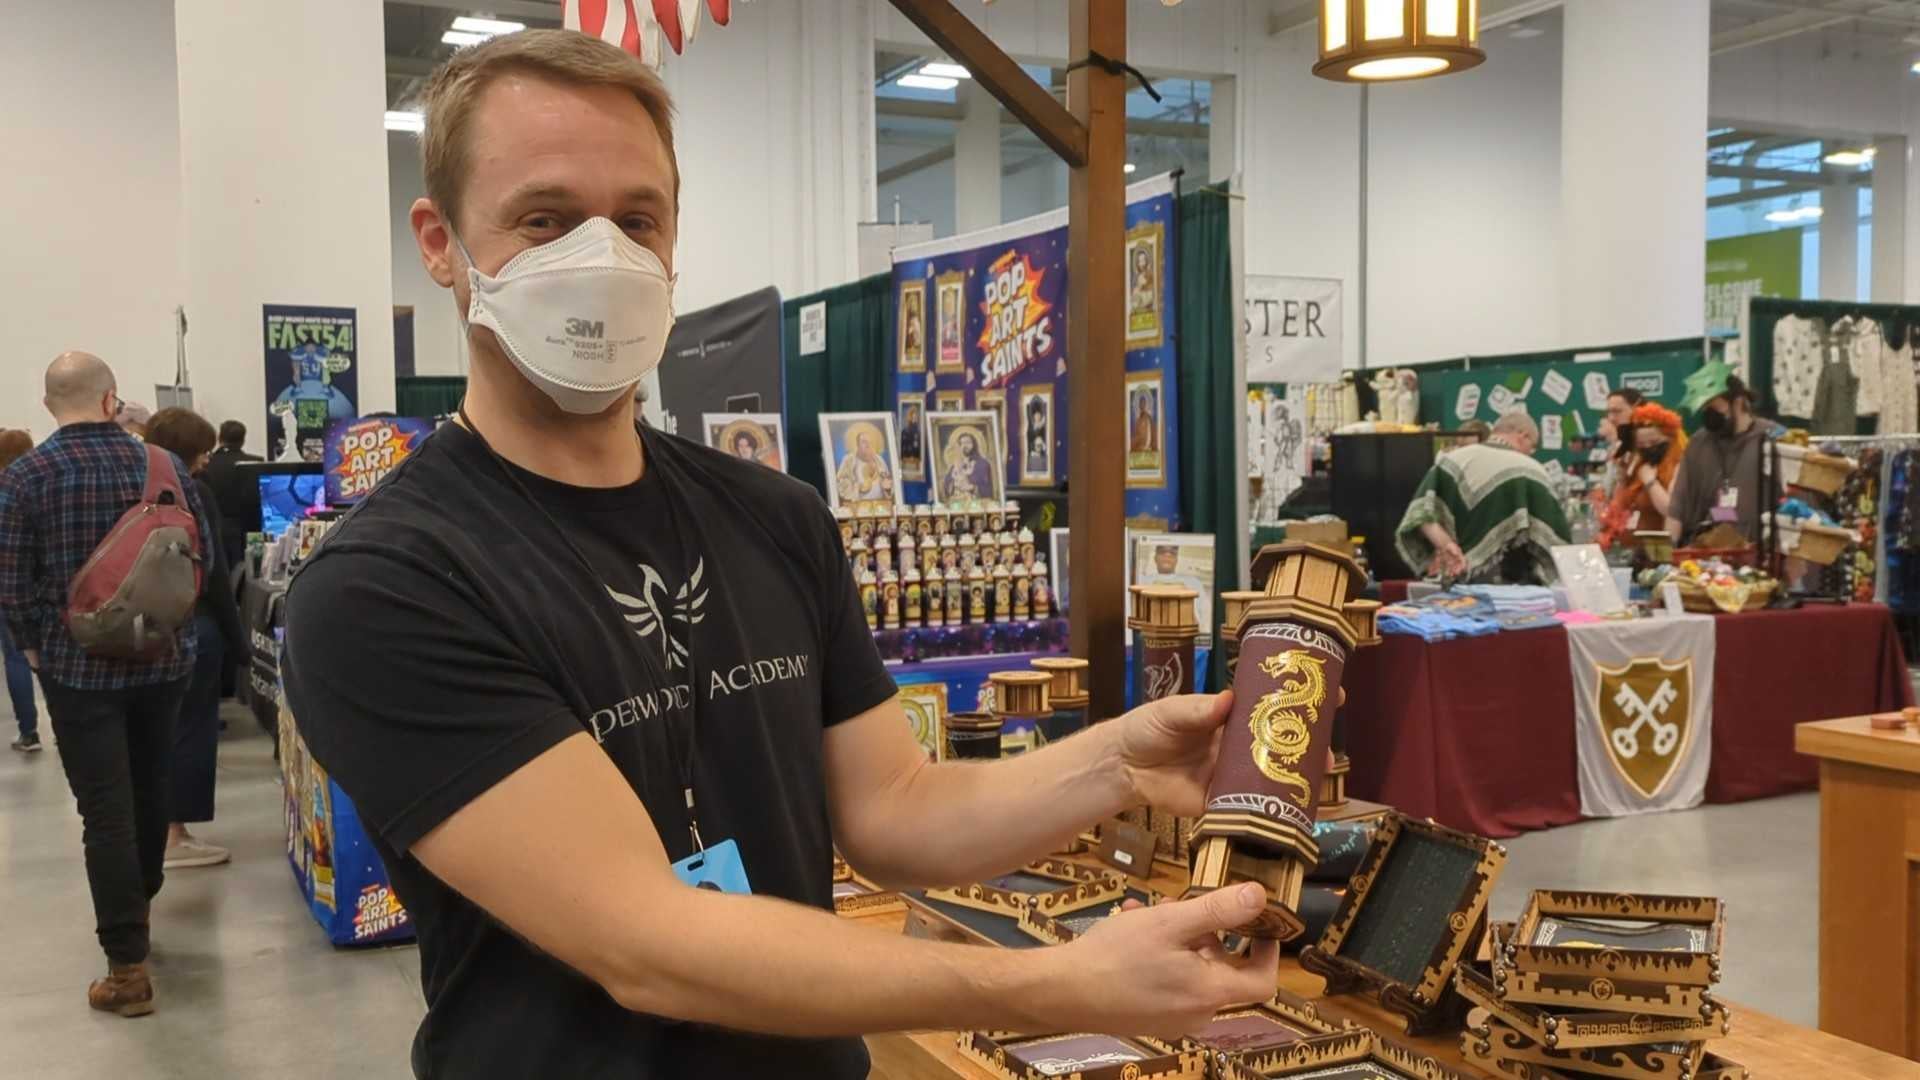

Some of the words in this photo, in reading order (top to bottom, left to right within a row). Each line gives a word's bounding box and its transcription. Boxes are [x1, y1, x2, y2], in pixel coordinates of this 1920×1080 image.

[984, 262, 1026, 315] POP
[565, 317, 605, 339] 3M
[989, 296, 1029, 348] ART
[981, 316, 1052, 387] SAINTS
[344, 427, 393, 455] POP
[350, 446, 394, 474] ART
[358, 887, 388, 910] POP
[362, 901, 390, 923] ART
[354, 908, 408, 940] SAINTS
